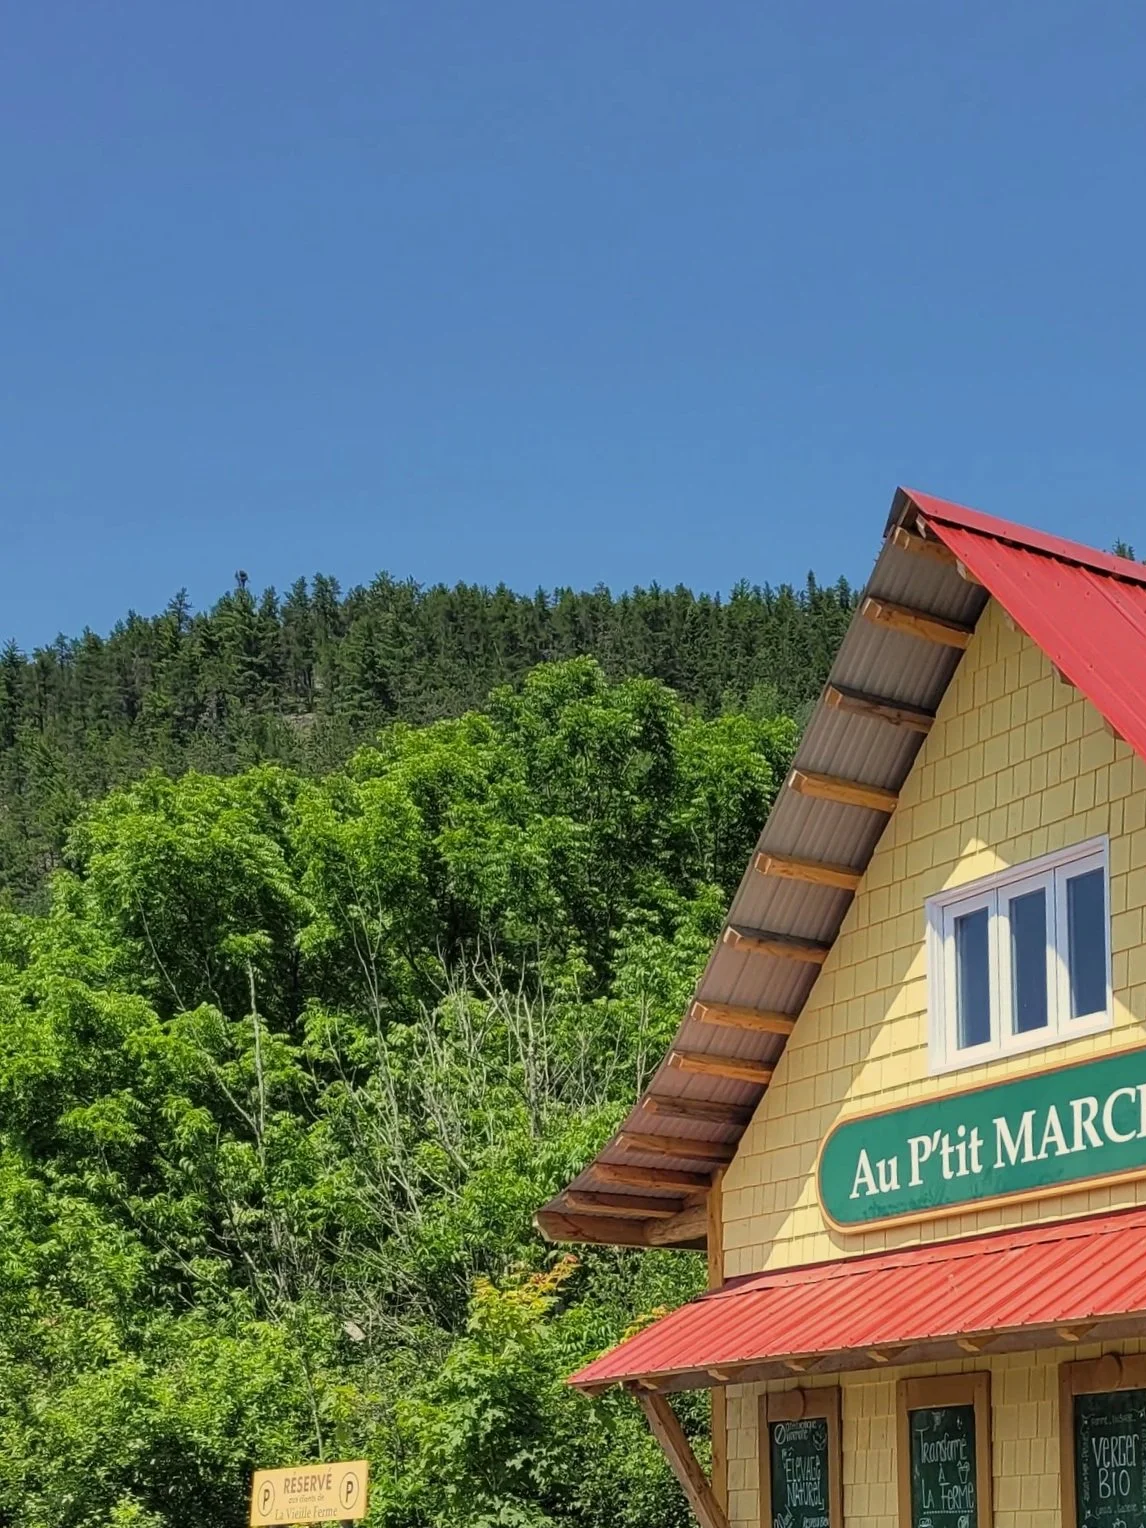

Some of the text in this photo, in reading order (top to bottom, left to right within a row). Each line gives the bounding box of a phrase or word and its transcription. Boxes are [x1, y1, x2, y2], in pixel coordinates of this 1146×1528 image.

[849, 1148, 900, 1199] Au
[908, 1123, 984, 1187] P'tit
[283, 1467, 332, 1494] RÉSERVÉ
